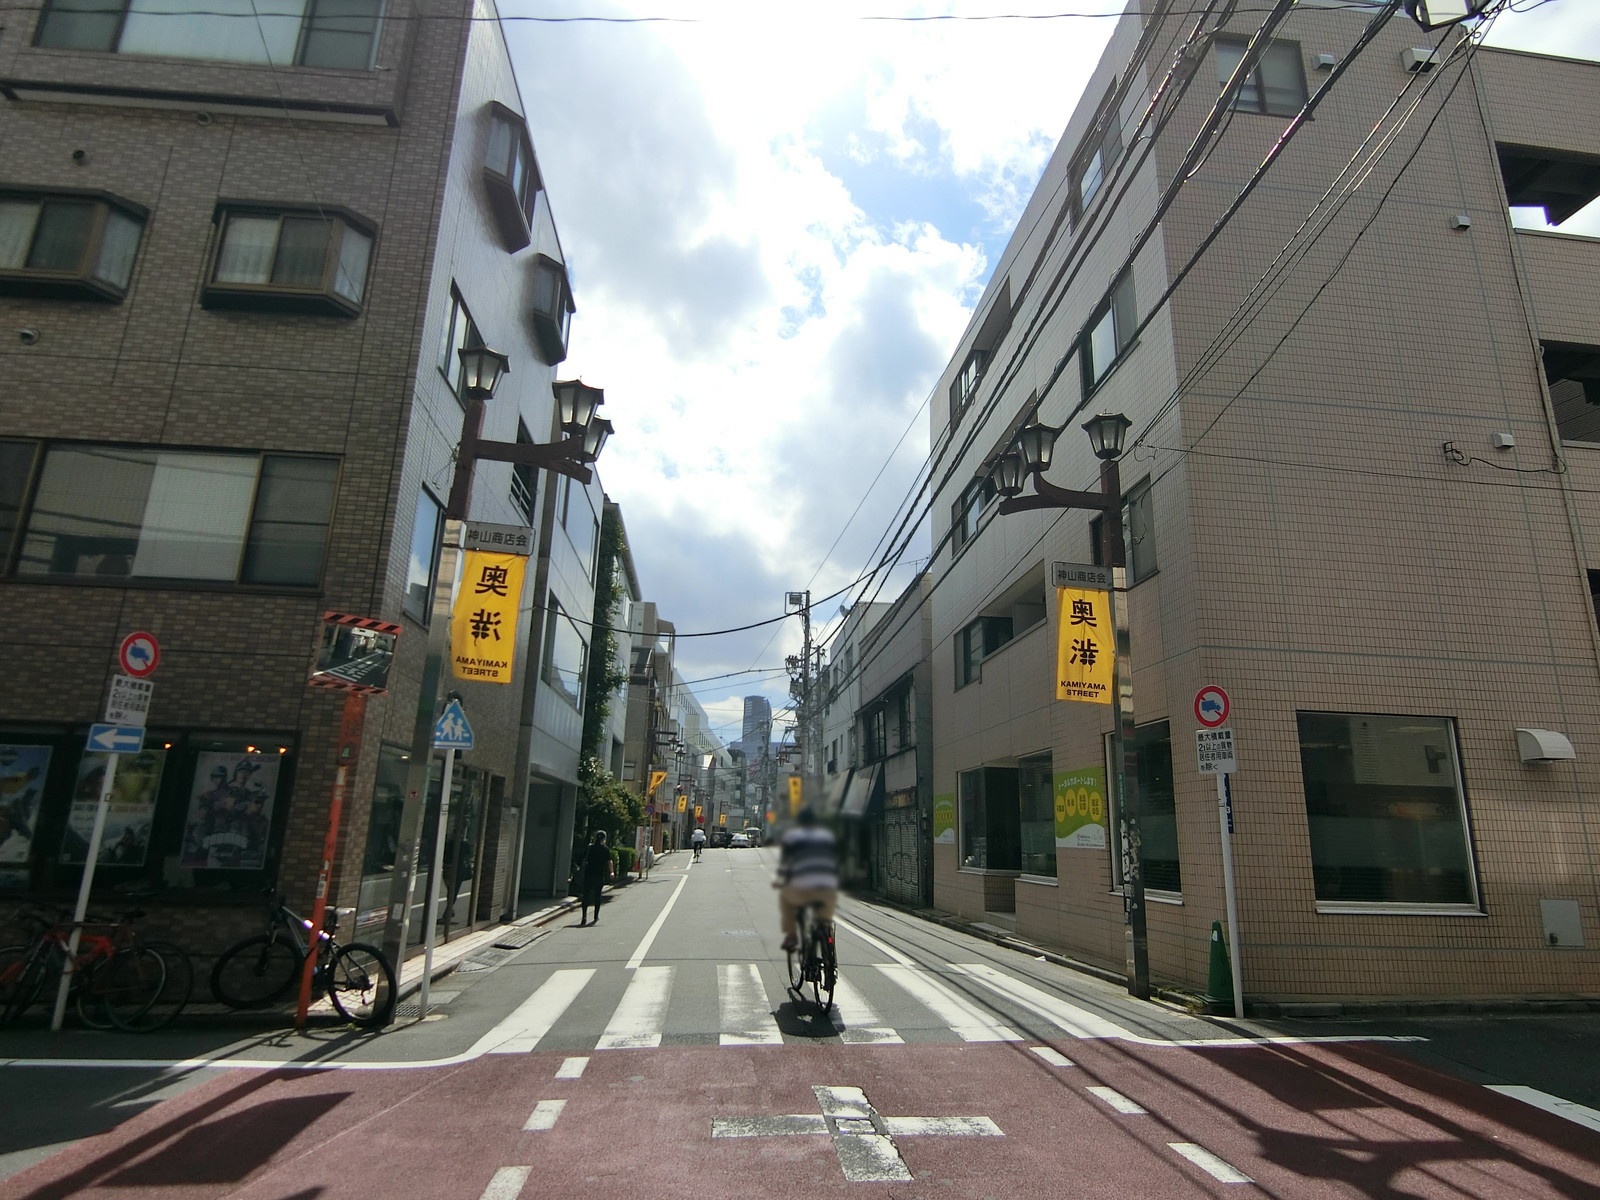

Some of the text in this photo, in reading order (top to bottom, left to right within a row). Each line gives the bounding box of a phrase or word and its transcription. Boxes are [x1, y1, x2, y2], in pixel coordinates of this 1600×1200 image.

[467, 529, 529, 547] 神山商店会
[1058, 569, 1107, 584] 神山商店会
[1061, 680, 1106, 691] KAMIYAMA
[1066, 689, 1099, 699] STREET
[1198, 731, 1231, 741] 最大積載量
[1200, 762, 1219, 771] を除く
